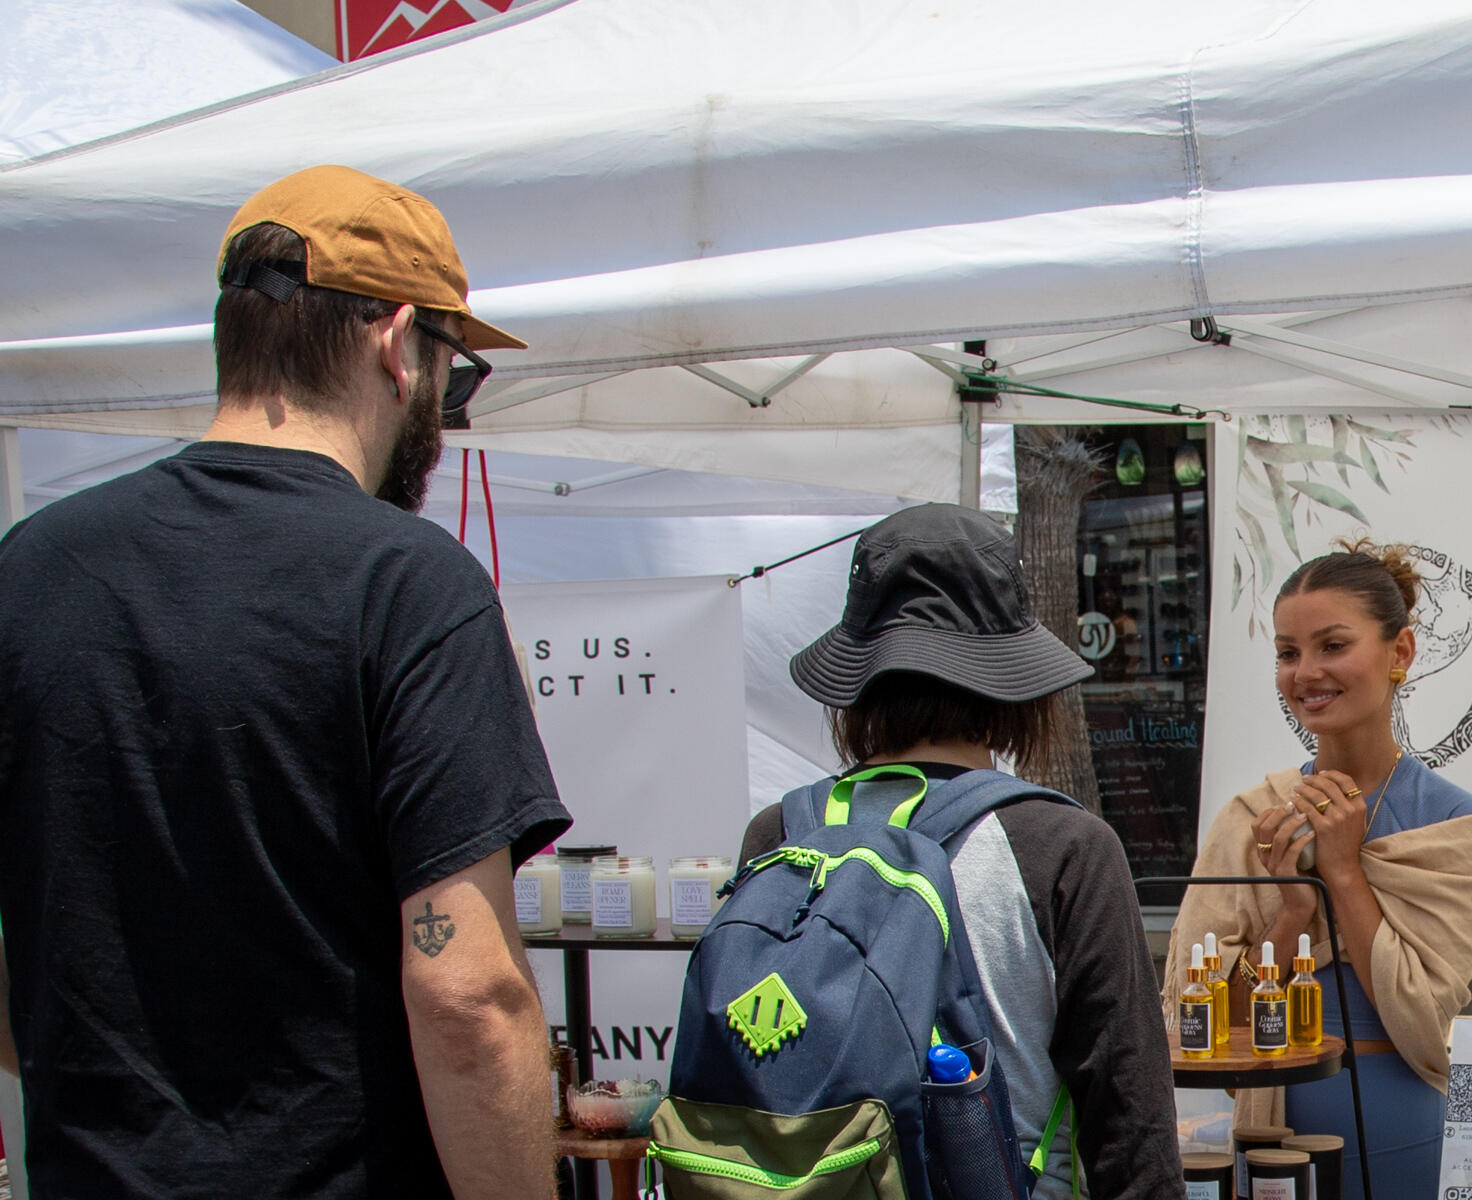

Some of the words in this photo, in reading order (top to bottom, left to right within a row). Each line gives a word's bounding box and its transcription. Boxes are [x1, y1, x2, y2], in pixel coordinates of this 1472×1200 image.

[583, 637, 651, 659] US.
[617, 673, 676, 697] IT.
[1090, 716, 1135, 744] ound
[1142, 717, 1198, 746] Healing
